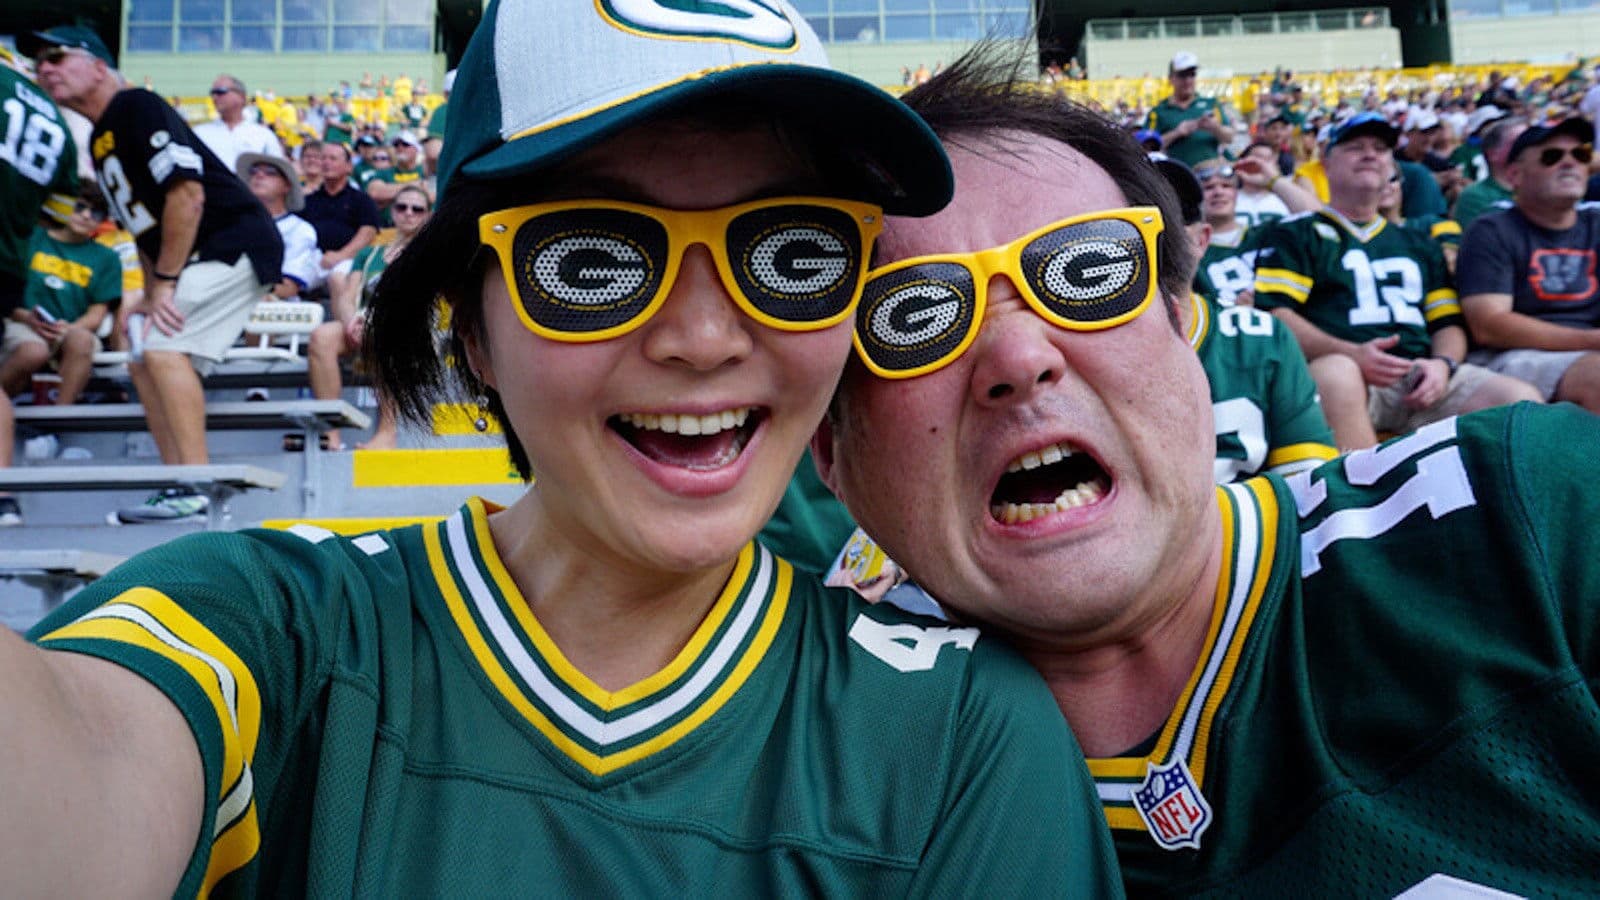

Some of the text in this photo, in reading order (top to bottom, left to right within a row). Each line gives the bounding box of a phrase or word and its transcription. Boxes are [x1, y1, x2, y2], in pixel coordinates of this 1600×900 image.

[0, 97, 66, 187] 18
[532, 234, 646, 305] G
[750, 227, 849, 296] G
[1043, 240, 1136, 301] G
[1341, 248, 1426, 326] 12
[248, 312, 313, 323] PACKERS
[871, 284, 960, 346] G
[1150, 792, 1201, 839] NFL
